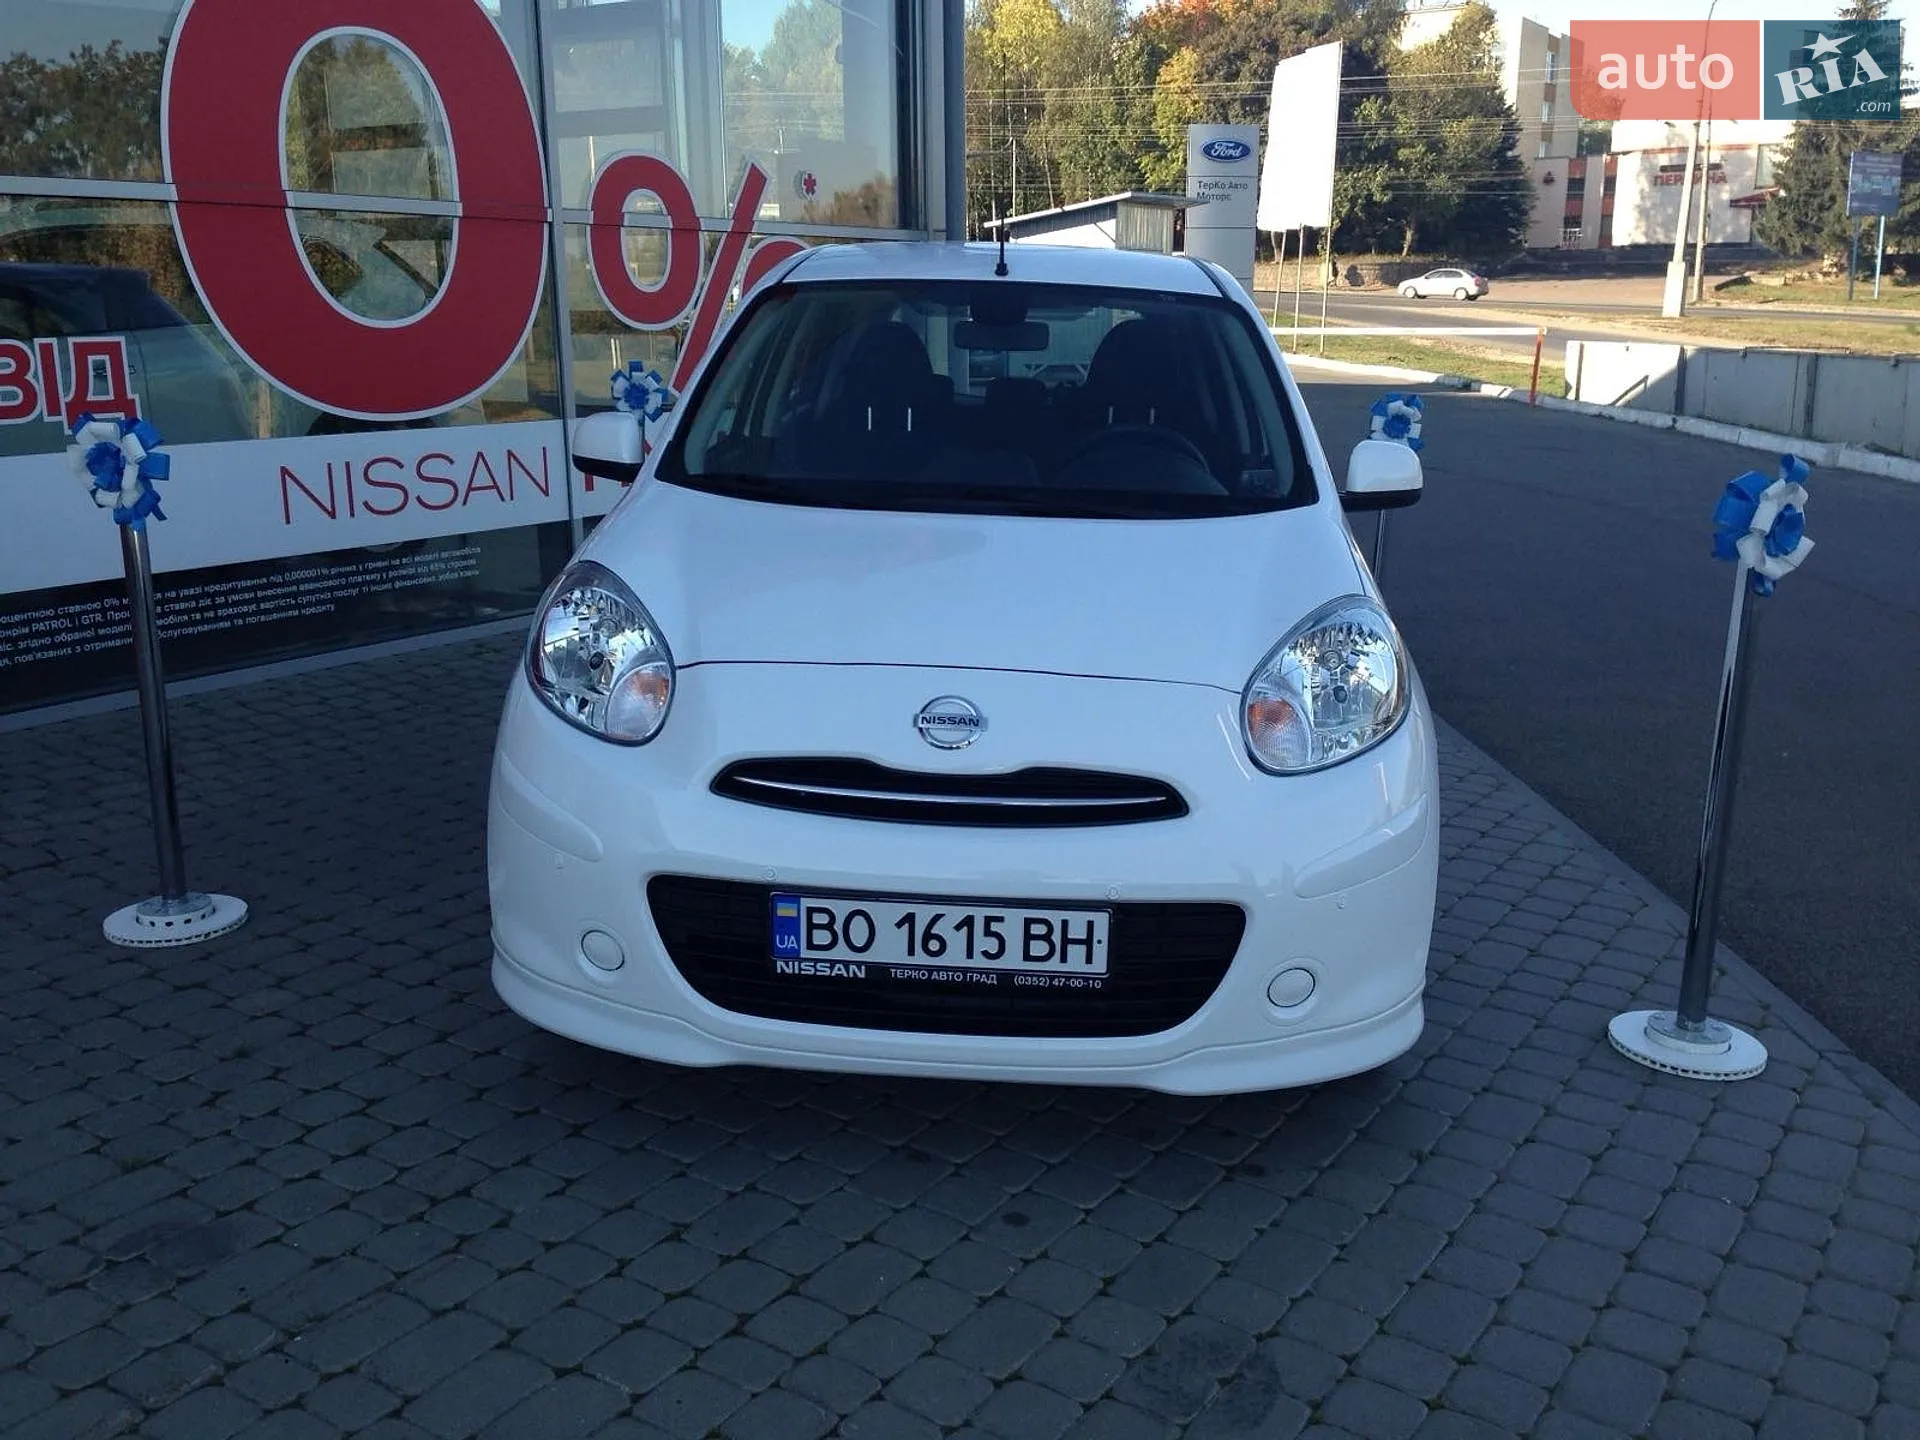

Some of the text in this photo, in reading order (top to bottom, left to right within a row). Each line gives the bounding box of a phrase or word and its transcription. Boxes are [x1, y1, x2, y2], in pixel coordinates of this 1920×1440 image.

[1210, 142, 1242, 157] Ford
[279, 446, 551, 525] NISSAN
[32, 617, 72, 633] PATROL
[921, 716, 980, 727] NISSAN
[776, 906, 1095, 965] UA BO 1615 BH
[776, 960, 867, 979] NISSAN
[931, 970, 964, 983] АВТО
[966, 971, 998, 985] ГРАД
[1014, 974, 1050, 988] (0352)
[1052, 976, 1102, 990] 47-00-10
